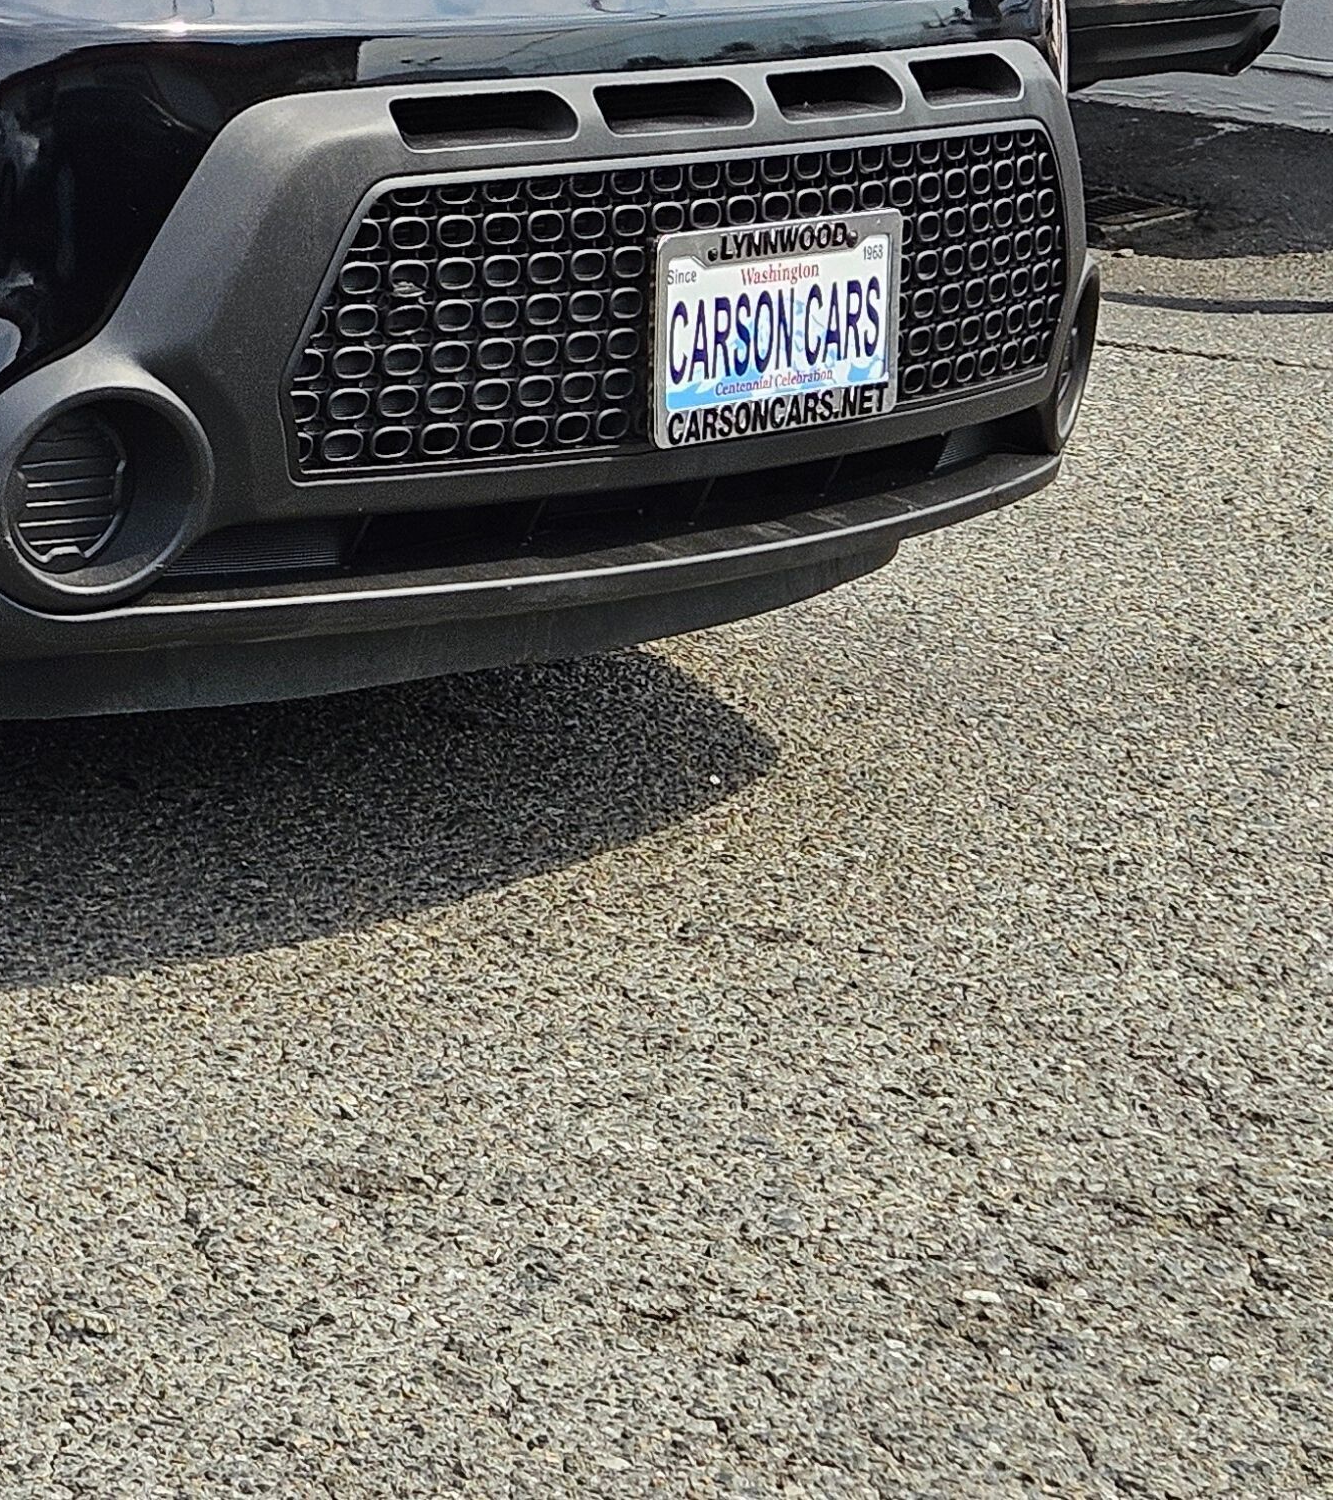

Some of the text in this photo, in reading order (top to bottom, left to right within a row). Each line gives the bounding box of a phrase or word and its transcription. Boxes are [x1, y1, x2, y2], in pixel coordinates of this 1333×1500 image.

[719, 222, 849, 261] LYNNWOOD
[666, 268, 697, 285] Since
[740, 263, 820, 286] Washington
[668, 276, 881, 385] CARSON CARS
[715, 368, 833, 398] Centennial Celebration
[667, 381, 890, 447] CARSONCARS.NET
